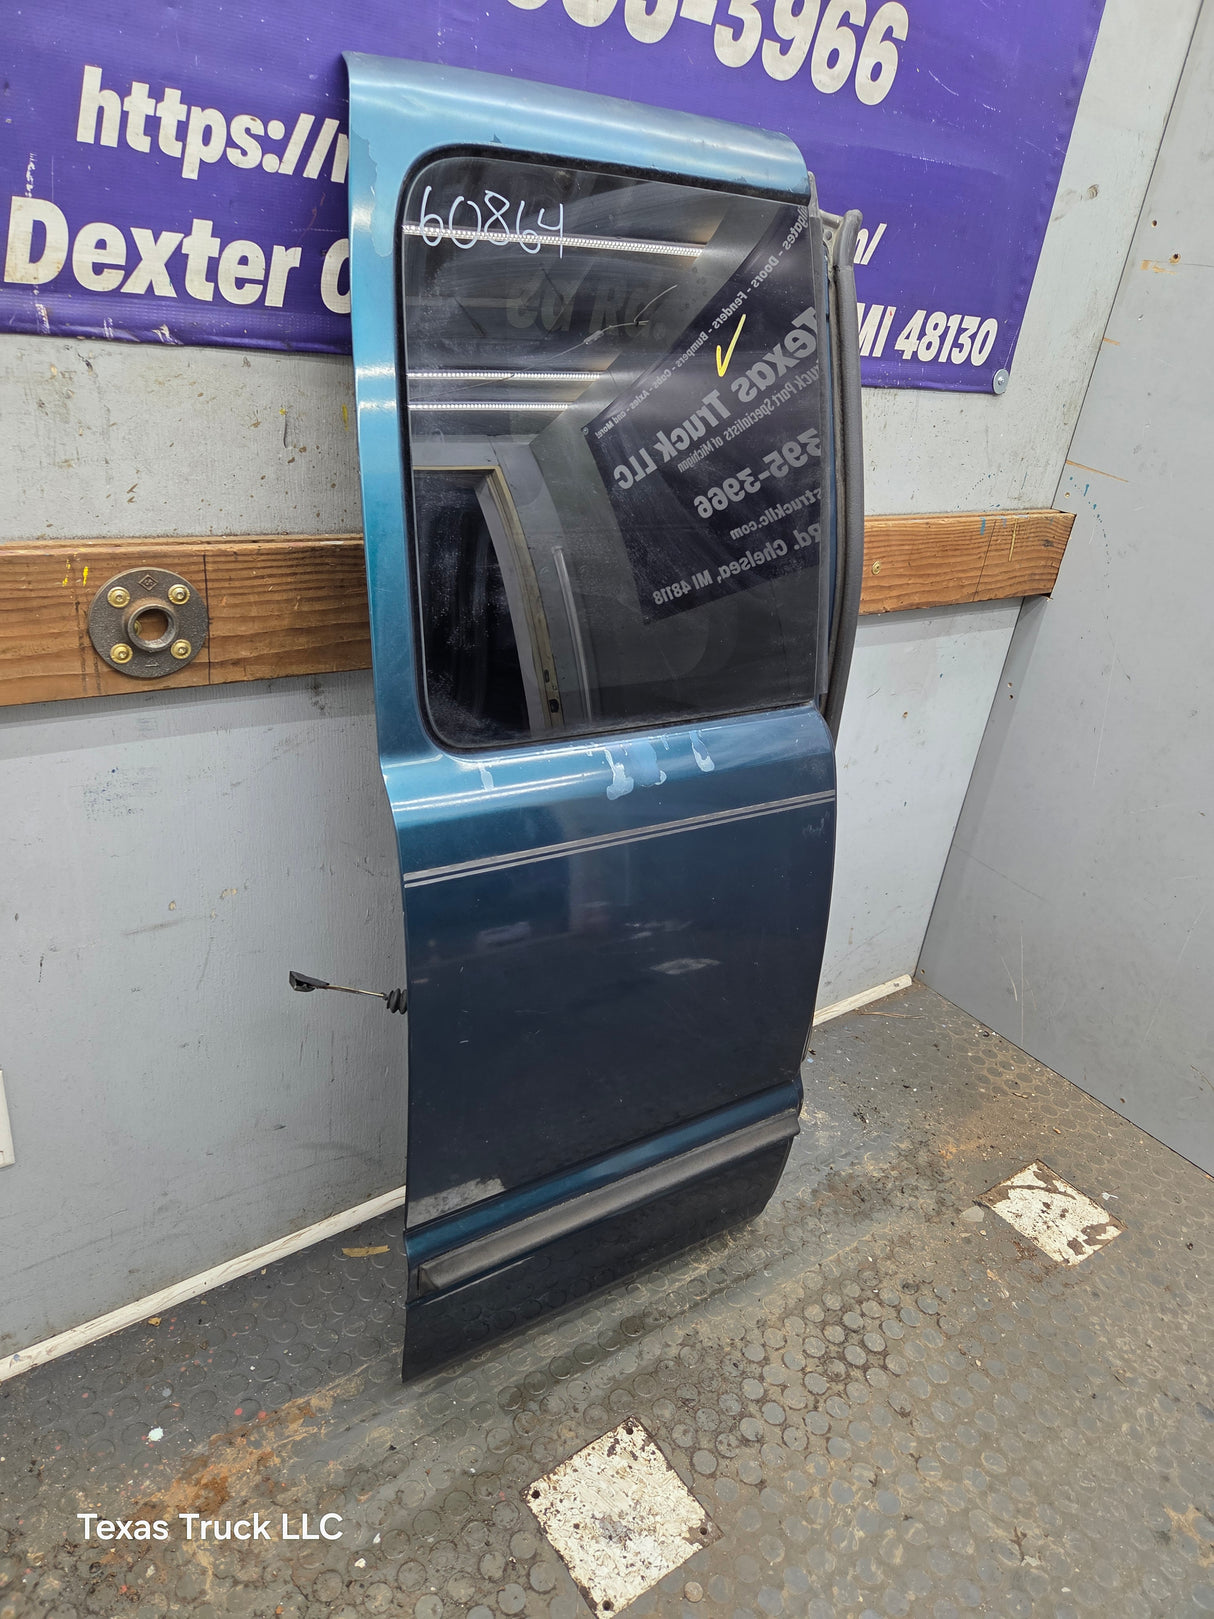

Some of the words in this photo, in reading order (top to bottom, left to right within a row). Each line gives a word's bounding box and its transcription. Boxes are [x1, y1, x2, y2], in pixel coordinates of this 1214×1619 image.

[4, 196, 302, 307] Dexter
[419, 185, 564, 259] 60864
[894, 309, 999, 367] 48130
